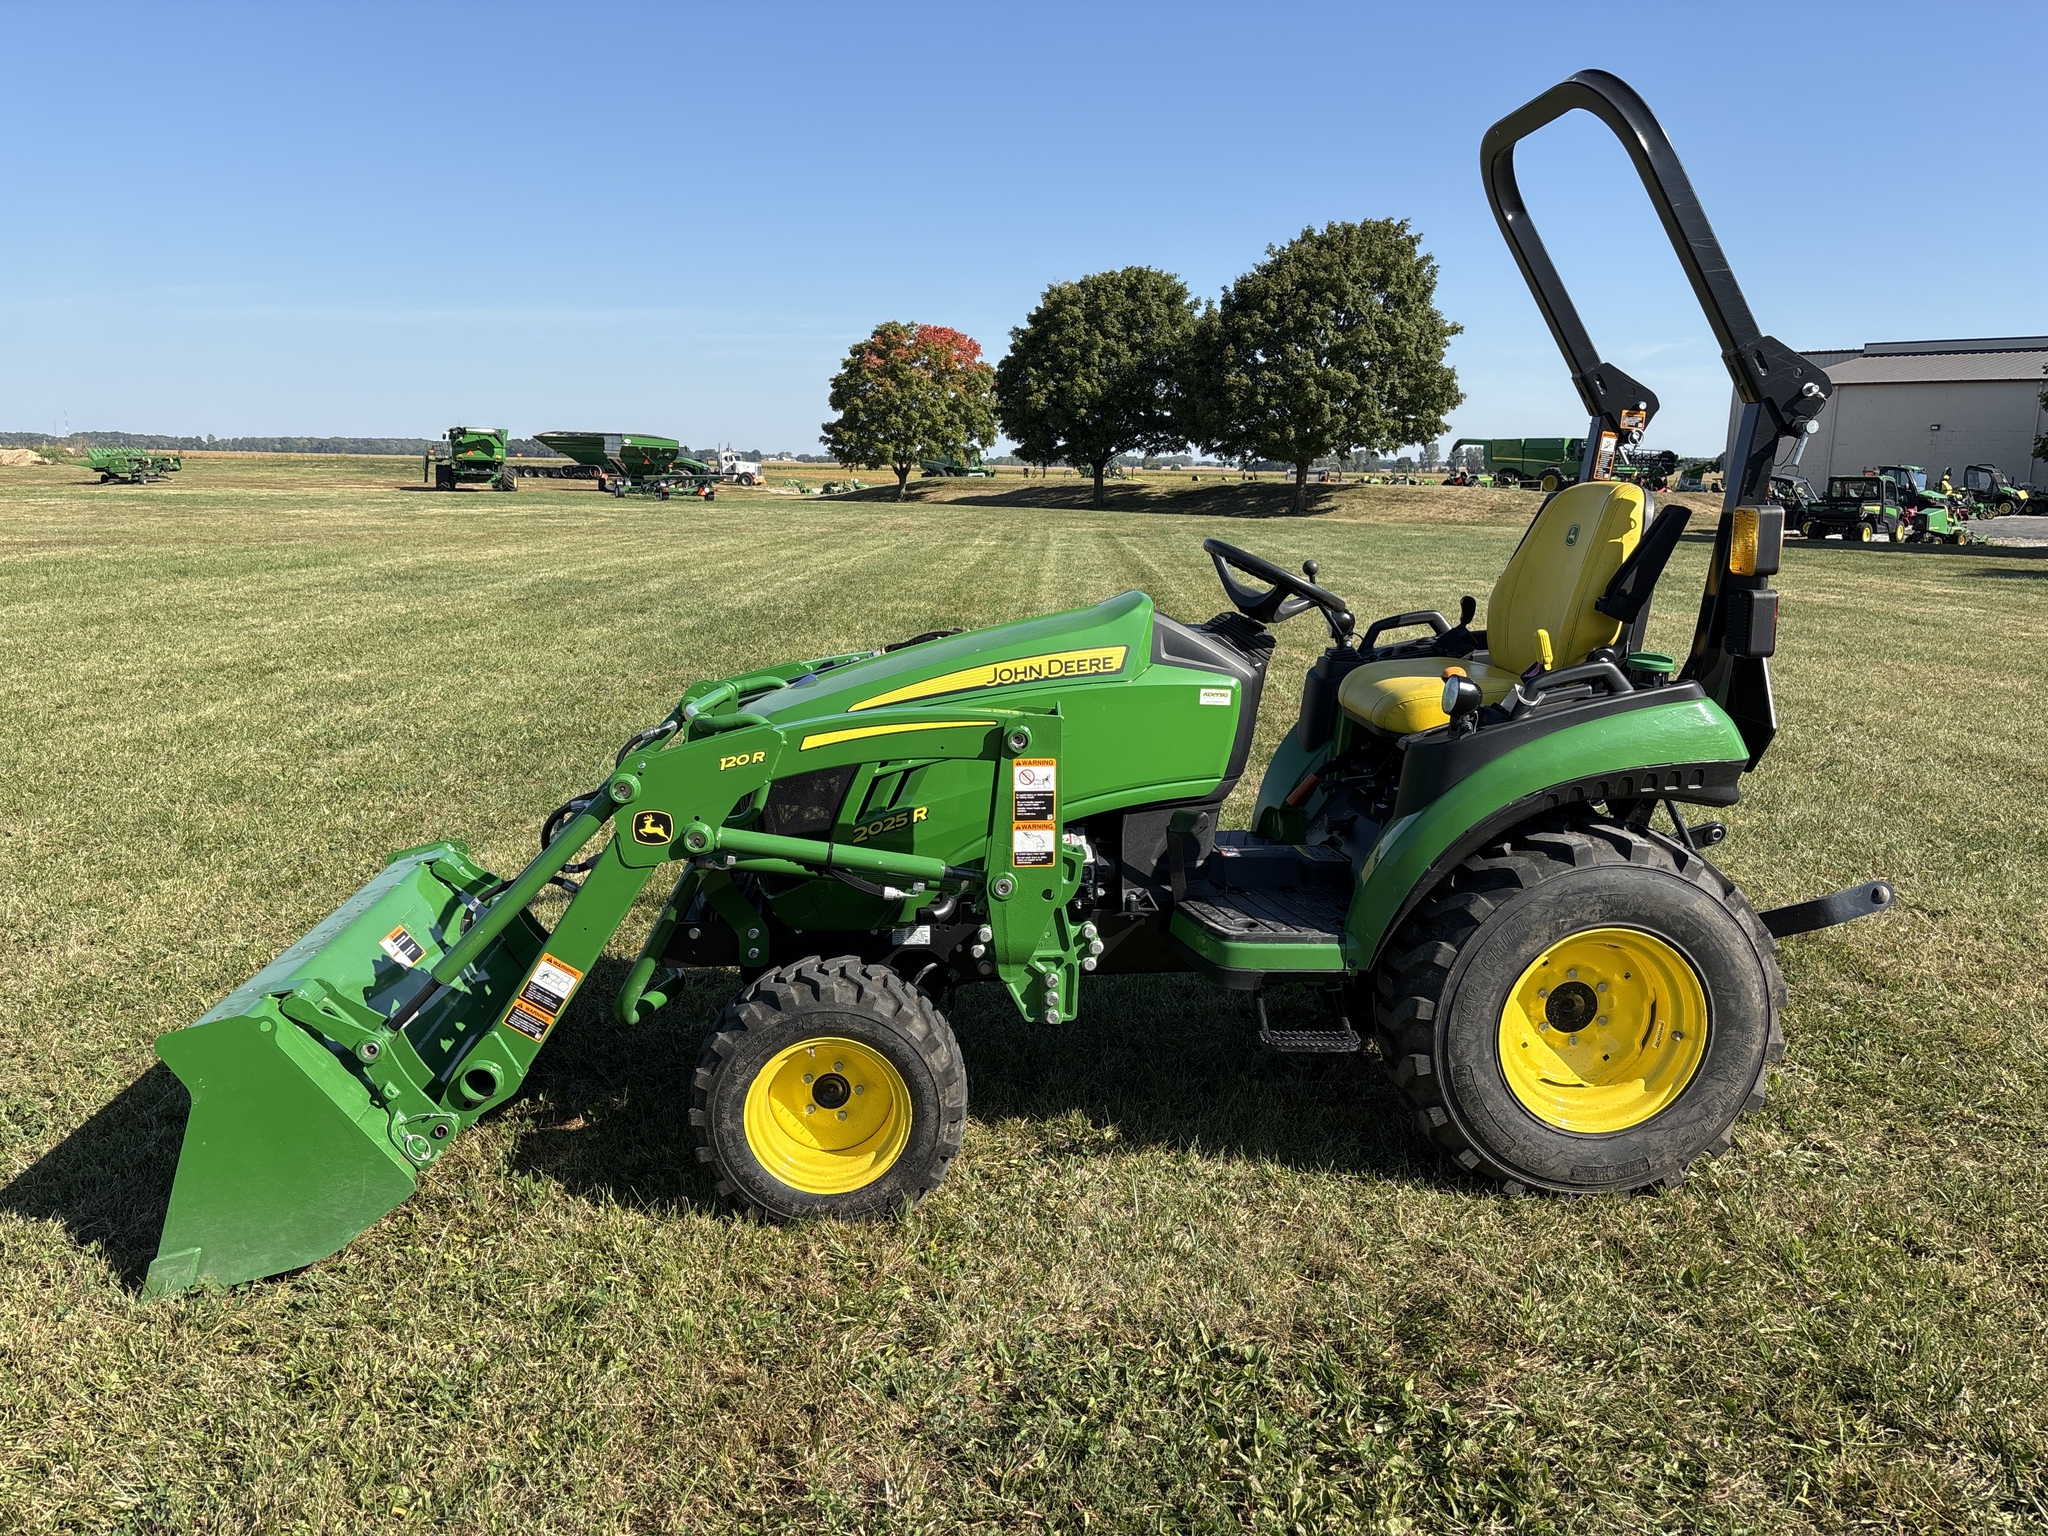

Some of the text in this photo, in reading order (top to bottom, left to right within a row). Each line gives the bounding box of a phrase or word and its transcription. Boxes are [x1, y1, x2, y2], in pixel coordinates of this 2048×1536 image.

[986, 656, 1114, 685] JOHN DEERE
[552, 959, 578, 977] WARNING
[524, 1005, 550, 1022] WARNING
